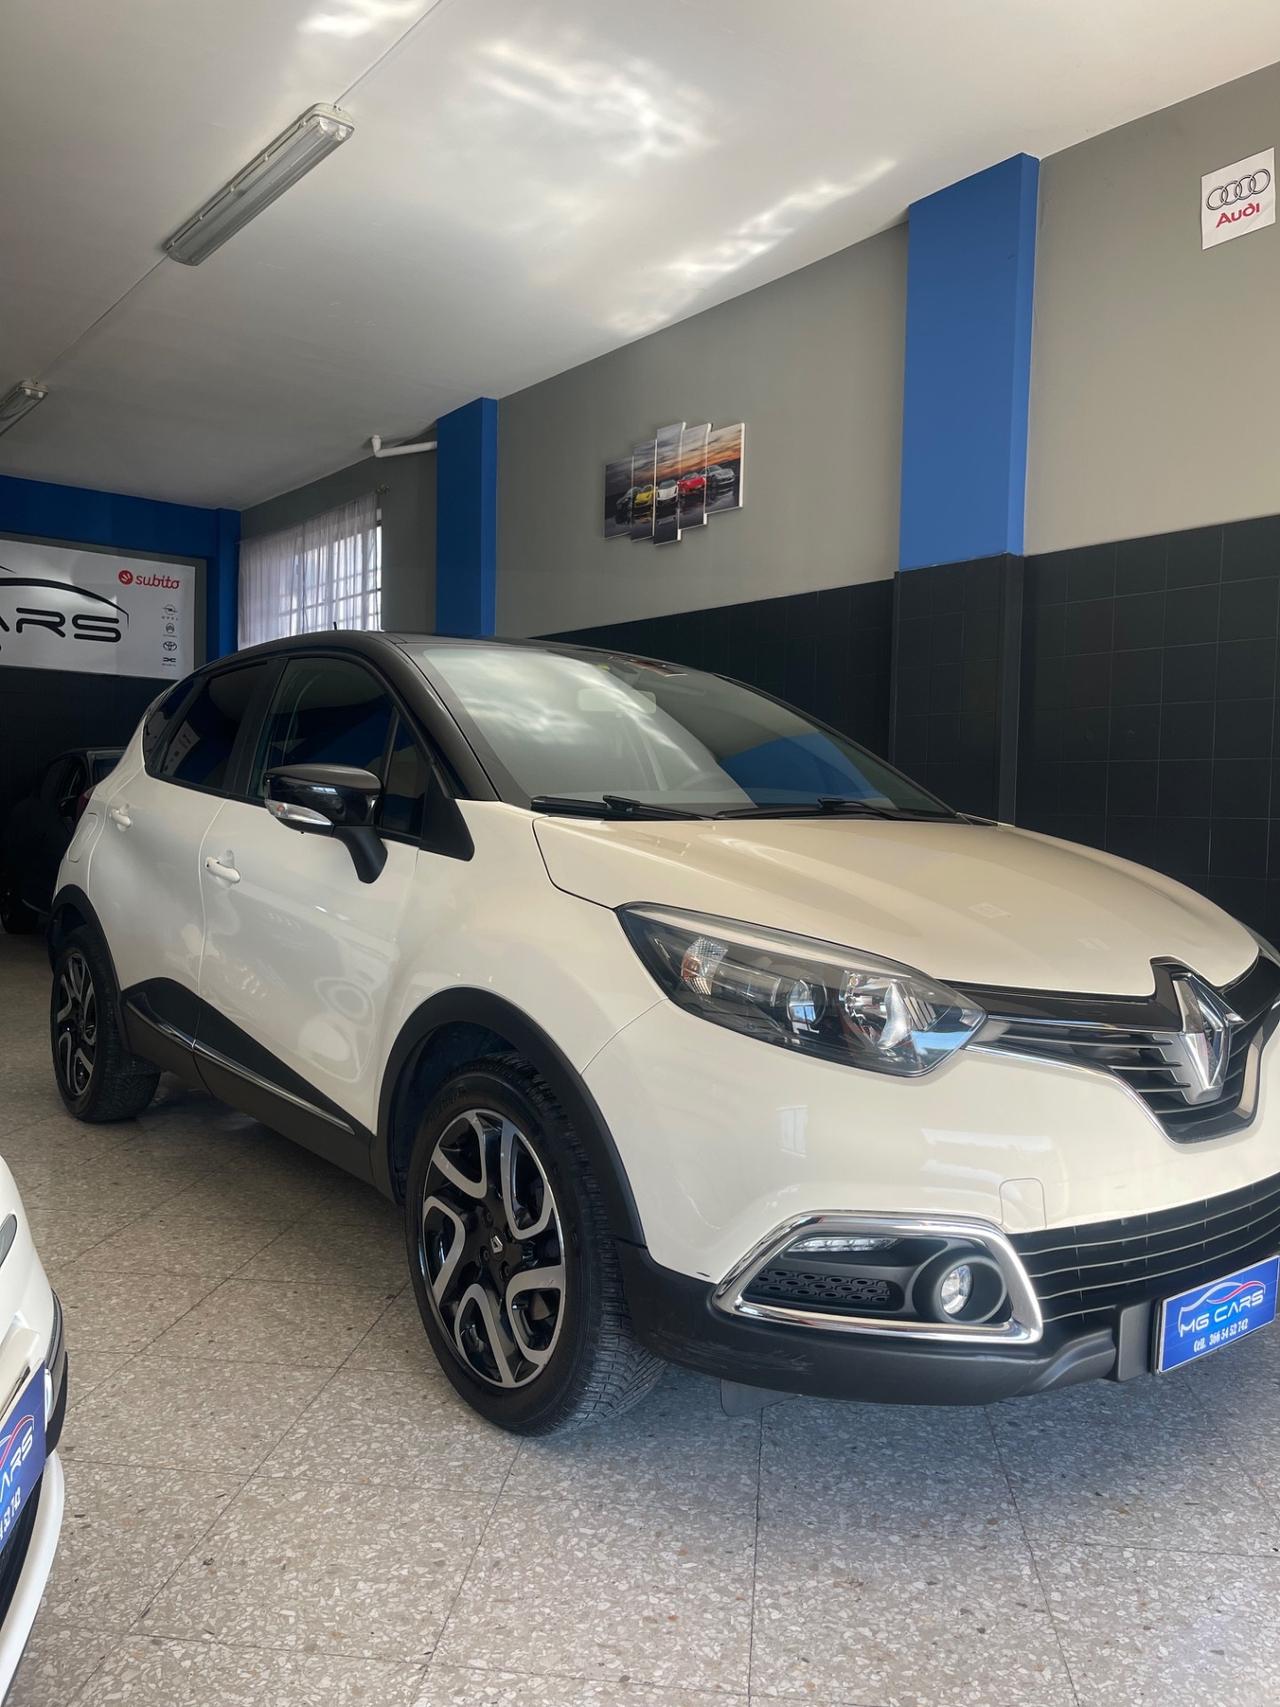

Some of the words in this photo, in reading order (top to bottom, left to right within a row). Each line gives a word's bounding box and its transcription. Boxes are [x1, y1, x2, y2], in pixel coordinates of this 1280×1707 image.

[1216, 203, 1260, 228] Audi
[135, 574, 180, 589] subito
[1180, 1313, 1210, 1338] MG
[1214, 1289, 1264, 1323] CARS
